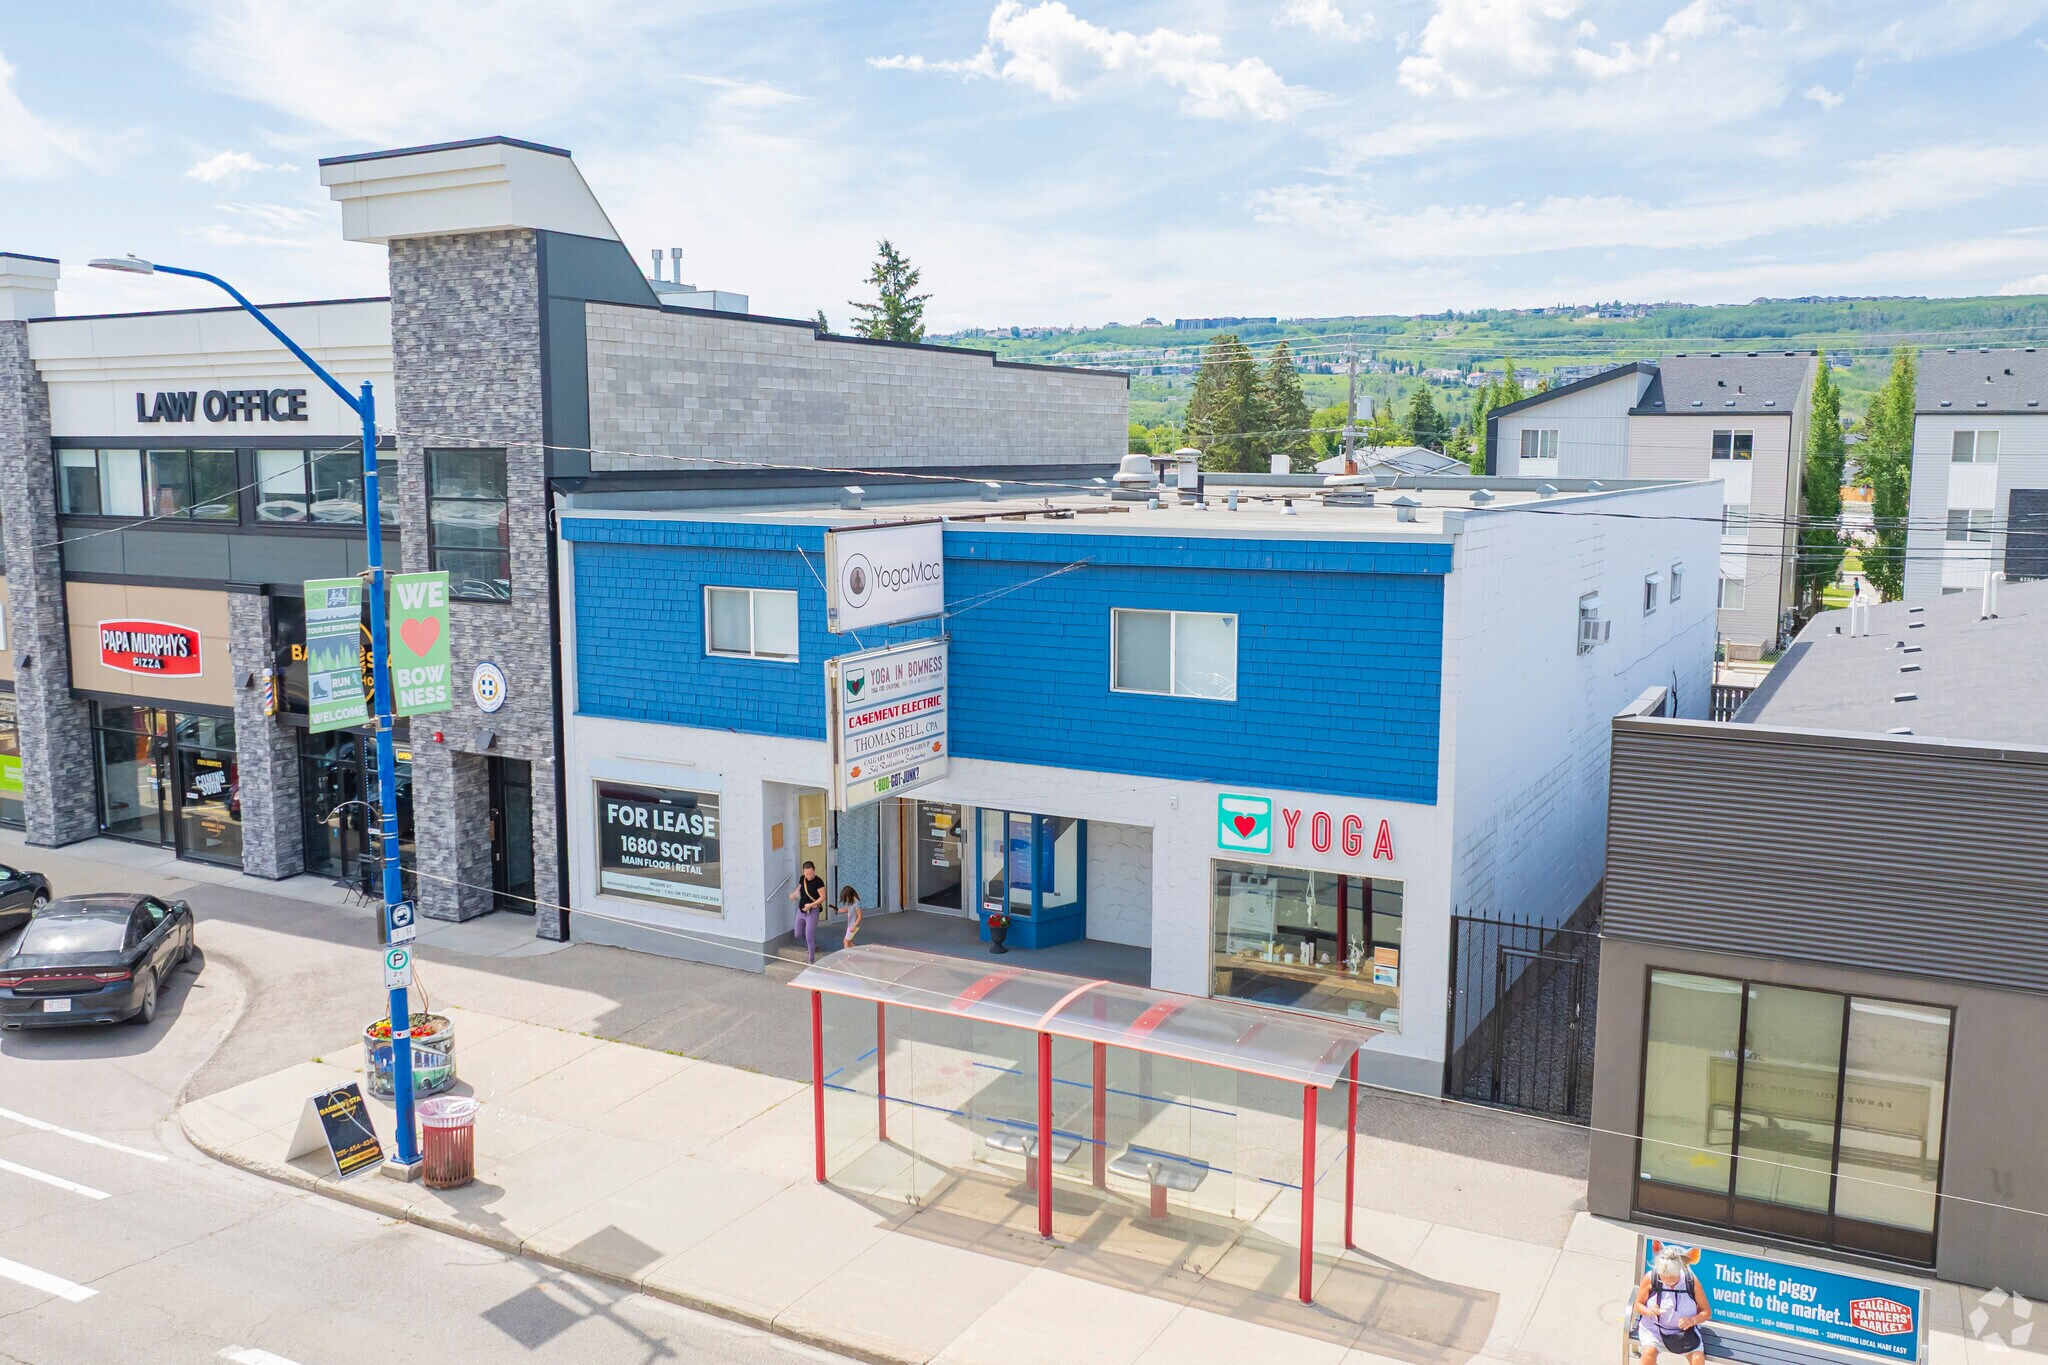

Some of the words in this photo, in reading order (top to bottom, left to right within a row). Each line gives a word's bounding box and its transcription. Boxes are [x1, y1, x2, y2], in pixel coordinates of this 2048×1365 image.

[136, 391, 197, 422] LAW
[203, 389, 308, 422] OFFICE
[873, 561, 940, 592] YogaMcc
[396, 581, 444, 610] WE
[307, 626, 323, 634] TOUR
[332, 623, 359, 631] BOWNESS
[102, 630, 130, 654] PAPA
[131, 632, 188, 657] MURPHY'S
[133, 657, 161, 669] PIZZA
[870, 666, 890, 686] YOGA
[895, 664, 903, 680] IN
[908, 655, 943, 678] BOWNESS
[332, 676, 351, 688] RUN
[396, 664, 446, 688] BOW
[333, 688, 362, 698] BOWNESS
[401, 685, 447, 708] NESS
[312, 705, 366, 725] WELCOME
[848, 705, 900, 729] CASEMENT
[901, 695, 942, 715] ELECTRIC
[854, 729, 896, 753] THOMAS
[898, 722, 924, 741] BELL,
[925, 721, 938, 732] CPA
[863, 755, 885, 766] CALGARY
[887, 746, 914, 758] MEDITATION
[914, 740, 930, 751] GROUP
[195, 770, 226, 788] COMING
[202, 781, 222, 796] SOON
[607, 803, 648, 829] FOR
[653, 809, 716, 837] LEASE
[1282, 807, 1394, 861] YOGA
[621, 835, 658, 856] 1680
[660, 841, 702, 862] SQFT
[621, 855, 644, 866] MAIN
[644, 858, 671, 870] FLOOR
[675, 863, 703, 875] RETAIL
[393, 953, 403, 966] P
[1714, 1263, 1742, 1284] This
[1744, 1269, 1776, 1291] little
[1778, 1277, 1817, 1303] piggy
[1713, 1287, 1746, 1303] went
[1748, 1291, 1763, 1309] to
[1766, 1293, 1788, 1315] the
[1791, 1303, 1853, 1328] market...
[1853, 1309, 1910, 1325] FARMERS'
[1858, 1299, 1903, 1313] CALGARY
[1714, 1308, 1726, 1317] TWO
[1726, 1310, 1754, 1322] LOCATIONS
[1775, 1320, 1796, 1332] UNIQUE
[1796, 1325, 1819, 1336] VENDORS
[1826, 1331, 1859, 1345] SUPPORTING
[1859, 1338, 1876, 1348] LOCAL
[1877, 1342, 1892, 1351] MADE
[1892, 1345, 1907, 1354] EASY
[1859, 1320, 1903, 1333] MARKET
